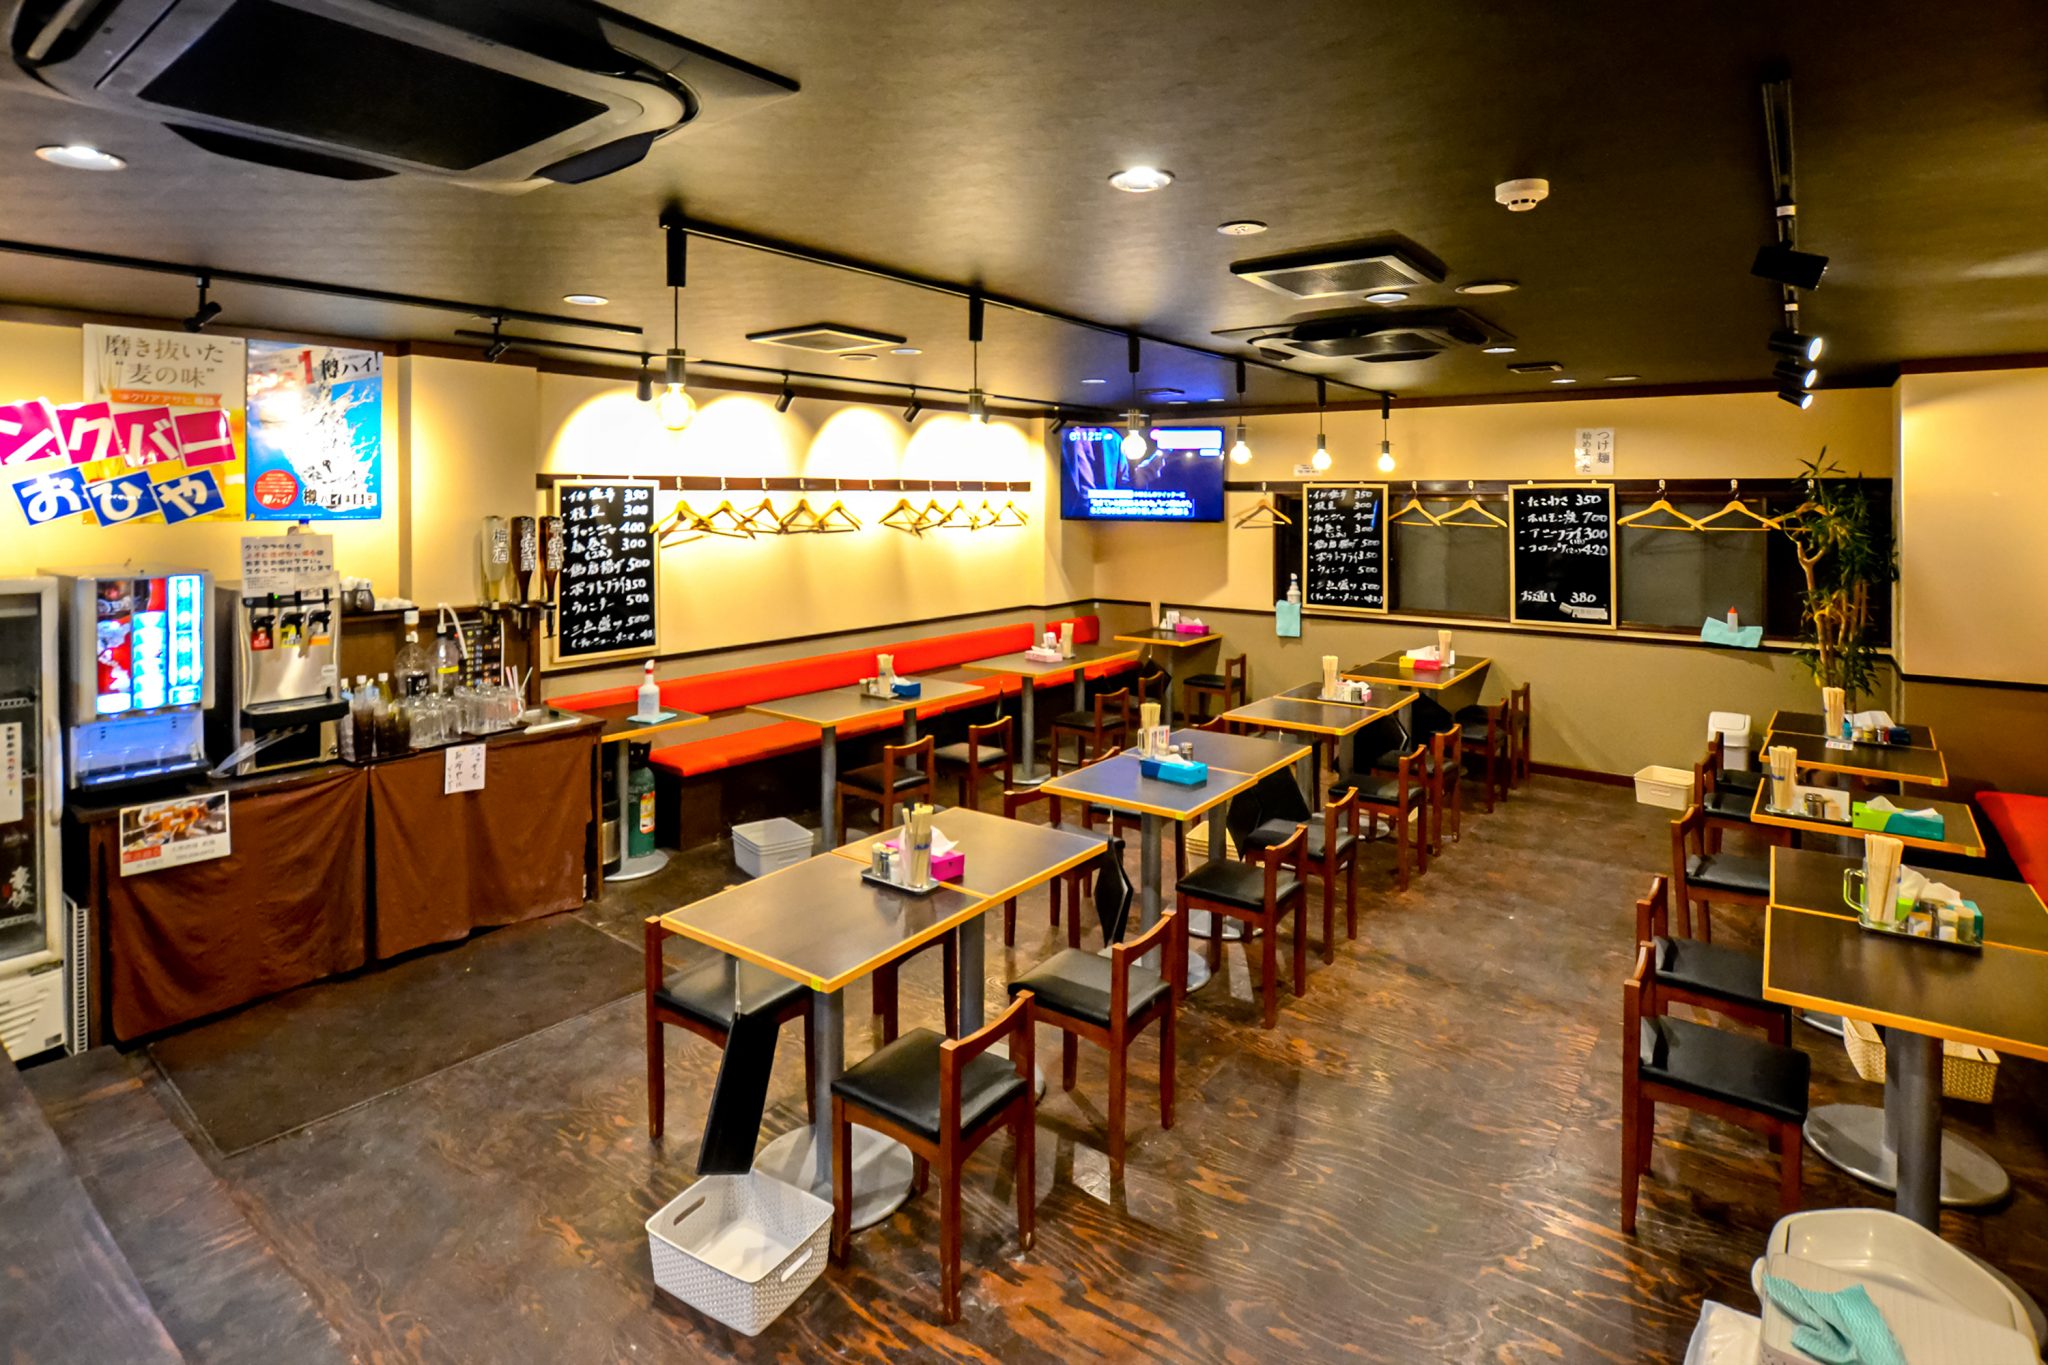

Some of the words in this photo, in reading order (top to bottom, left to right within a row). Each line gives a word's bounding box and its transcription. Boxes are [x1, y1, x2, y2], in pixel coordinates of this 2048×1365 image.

[105, 335, 224, 363] 磨き抜いた
[20, 477, 208, 522] おひや
[624, 489, 649, 502] 350
[1354, 490, 1373, 499] 350
[1527, 496, 1569, 507] たこわさ
[1575, 494, 1602, 506] 350
[623, 504, 648, 517] 300
[1353, 502, 1372, 511] 300
[1582, 511, 1608, 524] 700
[619, 521, 646, 534] 400
[1354, 523, 1374, 534] 300
[1583, 527, 1608, 540] 300
[621, 538, 647, 551] 300
[1360, 539, 1380, 547] 500
[1358, 550, 1378, 560] 350
[1581, 544, 1608, 556] 420
[626, 557, 651, 573] 500
[1357, 565, 1378, 574] 500
[625, 578, 647, 592] 350
[1360, 581, 1380, 590] 500
[626, 593, 649, 606] 500
[1570, 592, 1597, 603] 380
[625, 614, 650, 627] 500
